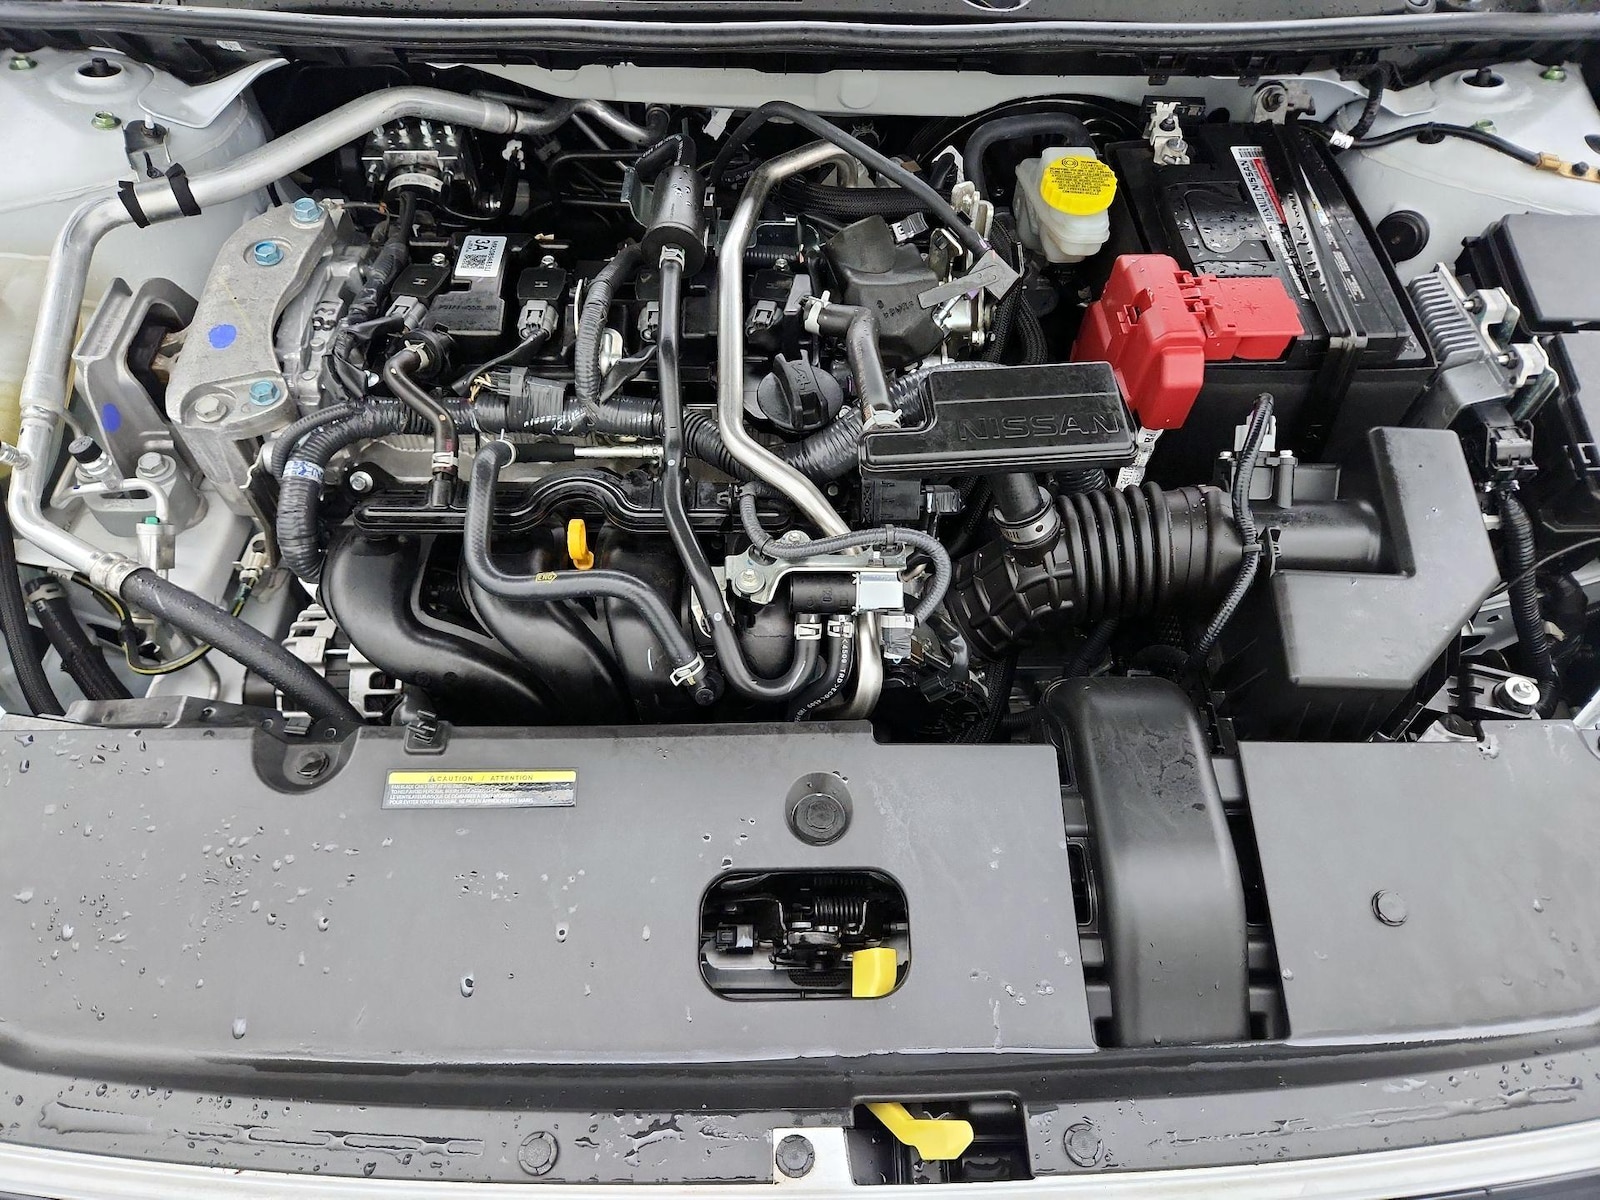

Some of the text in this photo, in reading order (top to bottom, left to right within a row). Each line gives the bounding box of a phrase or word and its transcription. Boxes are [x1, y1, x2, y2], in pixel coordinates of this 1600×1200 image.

[1239, 159, 1260, 193] NISSAN
[472, 239, 490, 252] 3A
[959, 411, 1121, 441] NISSAN
